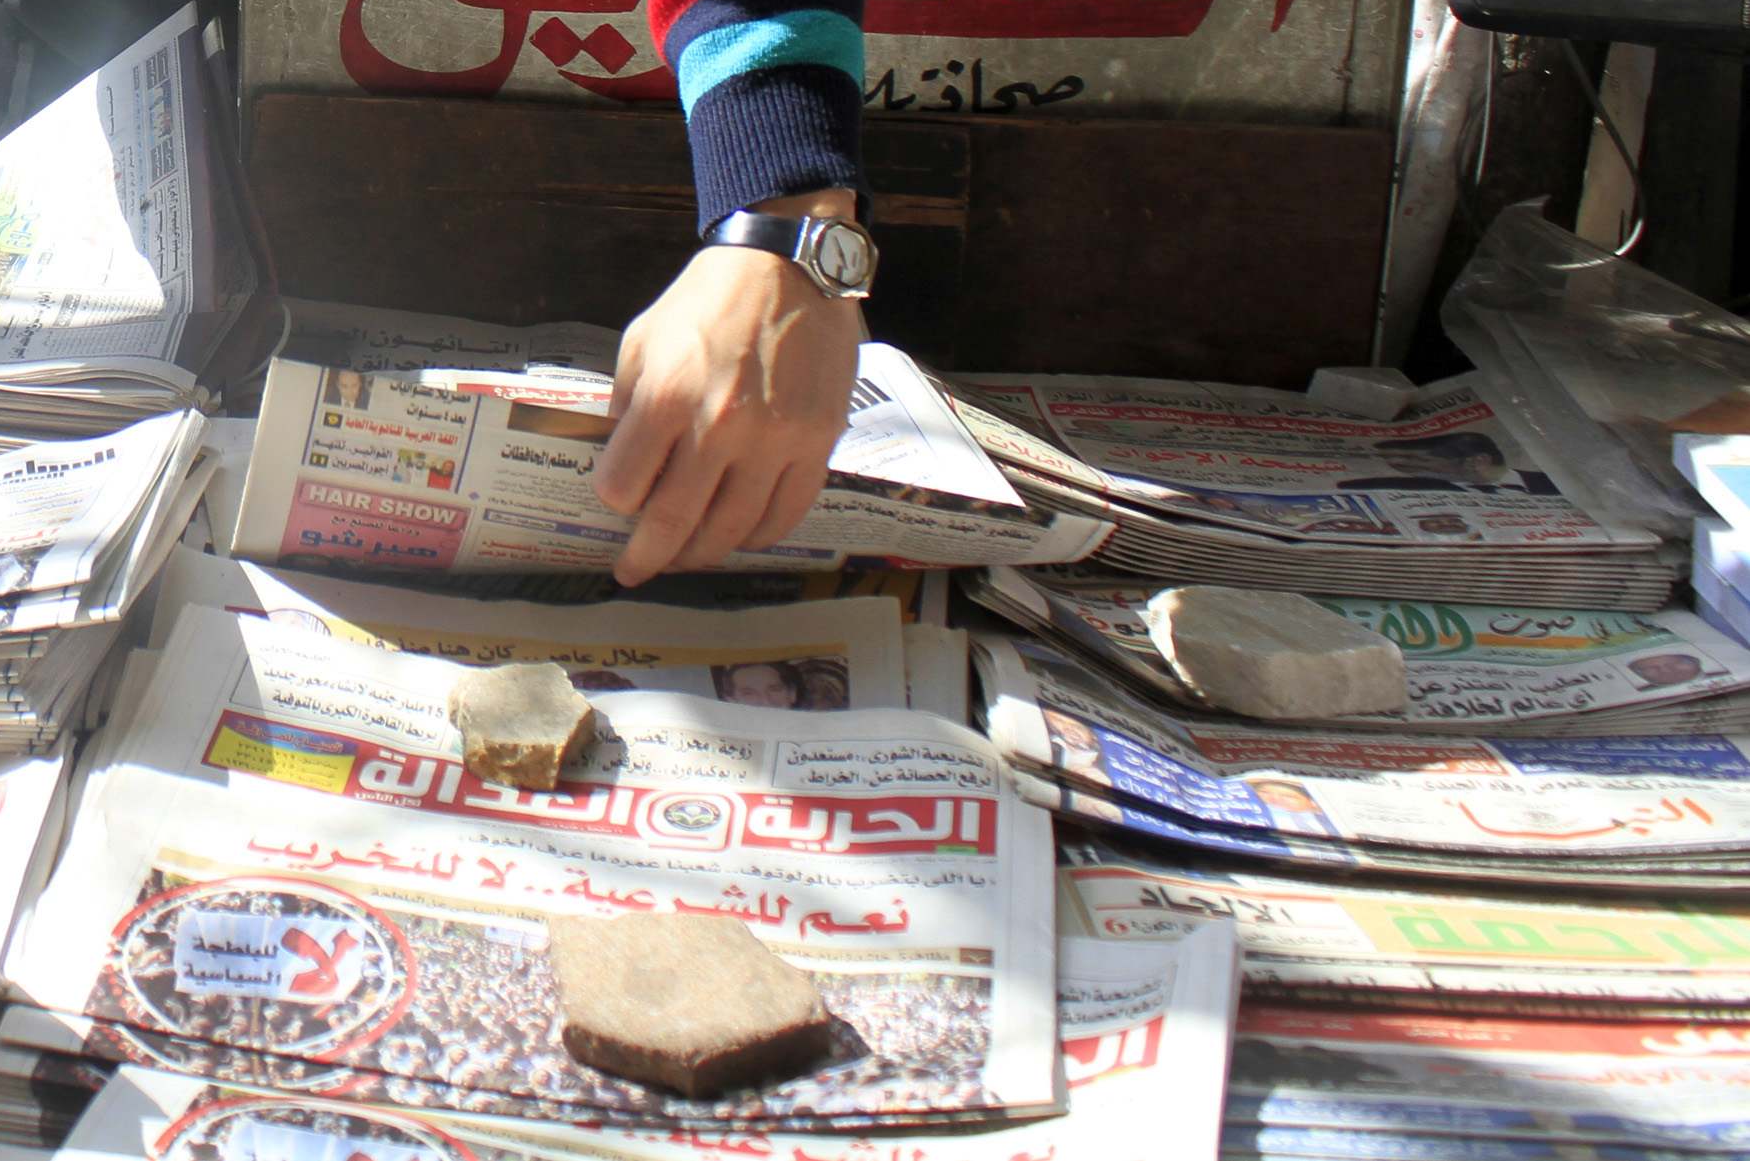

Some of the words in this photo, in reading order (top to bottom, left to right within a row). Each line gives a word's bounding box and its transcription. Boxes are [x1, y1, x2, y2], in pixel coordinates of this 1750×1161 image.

[920, 58, 1085, 114] صحافة
[406, 405, 442, 422] سنوات
[308, 486, 373, 511] HAIR
[378, 497, 457, 525] SHOW
[1488, 612, 1576, 642] صوت
[438, 641, 471, 657] هنا
[477, 643, 517, 663] كان
[601, 647, 662, 671] جلال
[1408, 679, 1443, 703] عن
[321, 699, 363, 722] الكبرى
[360, 710, 408, 734] القاهرة
[1511, 696, 1564, 723] عالم
[718, 738, 753, 762] زوجة
[786, 745, 855, 772] مستعدون
[869, 772, 894, 790] عن
[895, 765, 957, 789] الحصانة
[958, 771, 992, 791] لرفع
[751, 791, 982, 853] الحرية
[246, 834, 467, 888] للتخريب
[476, 854, 532, 892] لا
[666, 860, 723, 875] شعبنا
[777, 896, 914, 938] نعم
[189, 936, 281, 963] للبلطجة
[281, 918, 361, 1003] لا
[180, 963, 285, 994] السياسية
